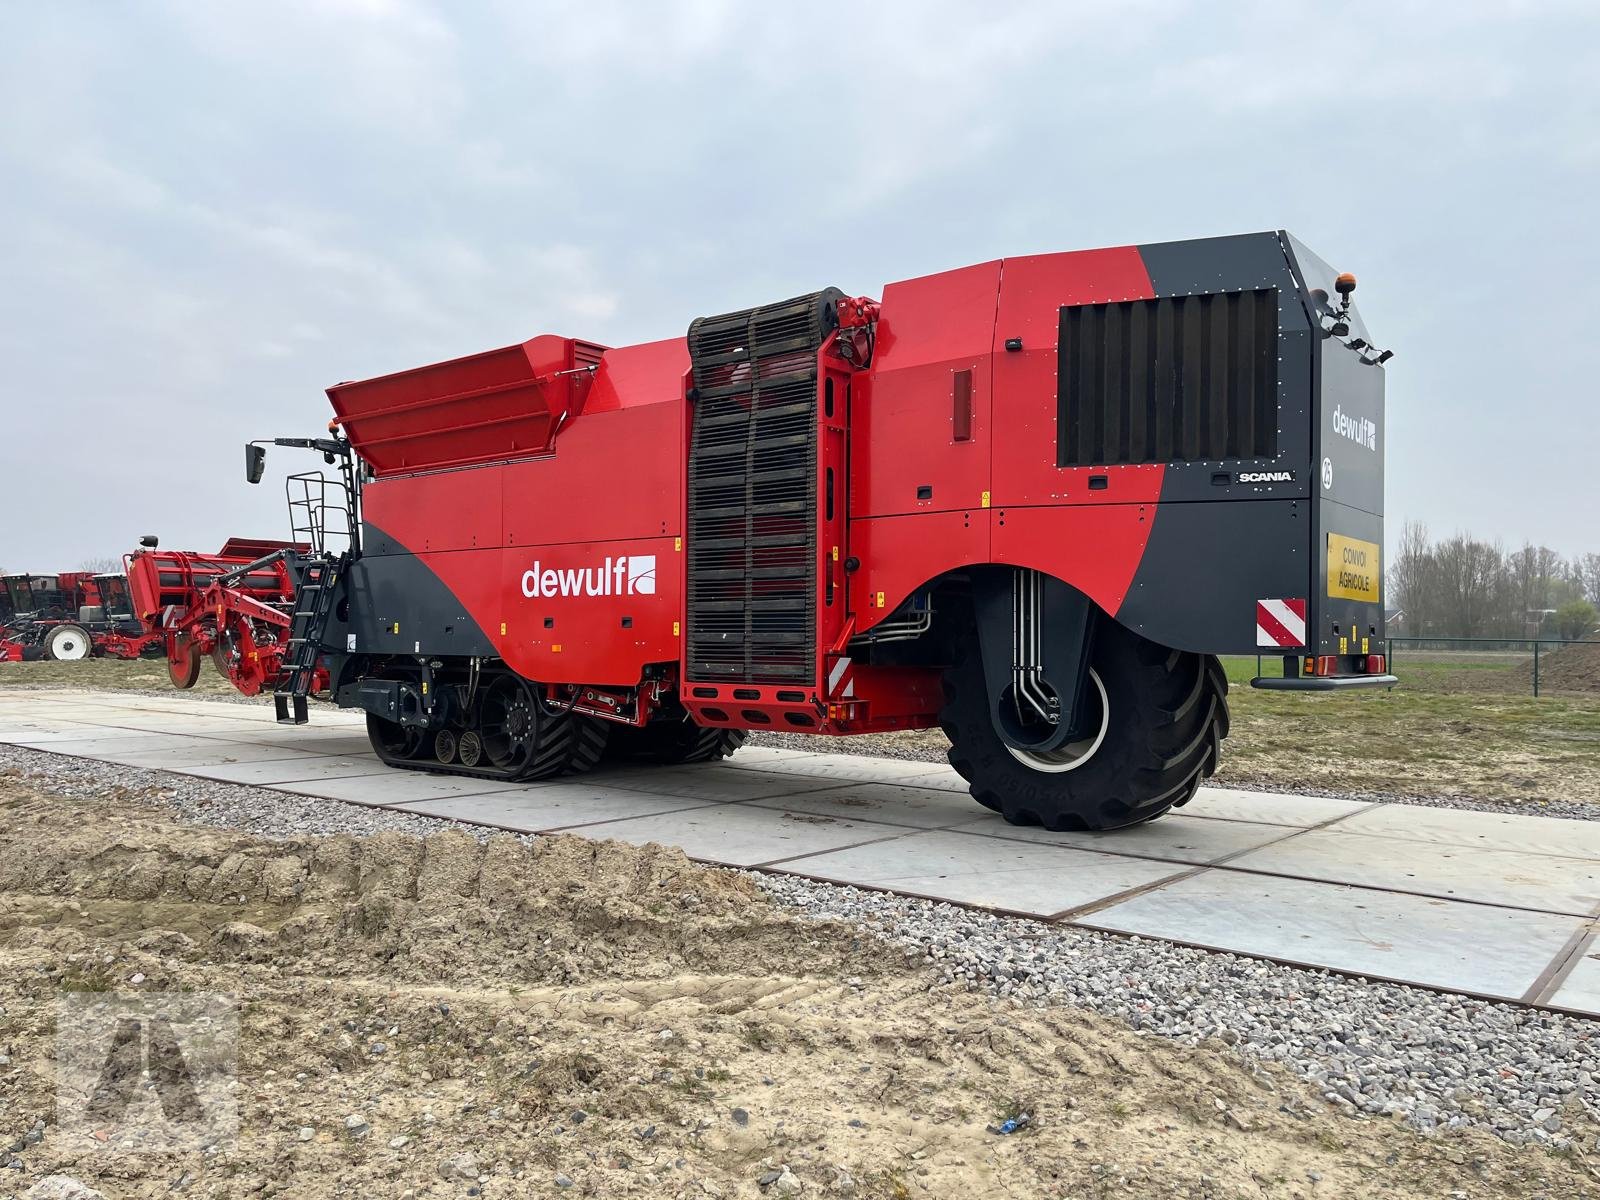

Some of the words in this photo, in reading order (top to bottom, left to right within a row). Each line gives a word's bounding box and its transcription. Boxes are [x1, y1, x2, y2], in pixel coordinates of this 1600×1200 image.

[1333, 404, 1367, 447] dewulf
[1239, 472, 1292, 482] SCANIA
[1343, 547, 1366, 568] CONVOI
[521, 556, 627, 598] dewulf
[1339, 571, 1369, 592] AGRICOLE
